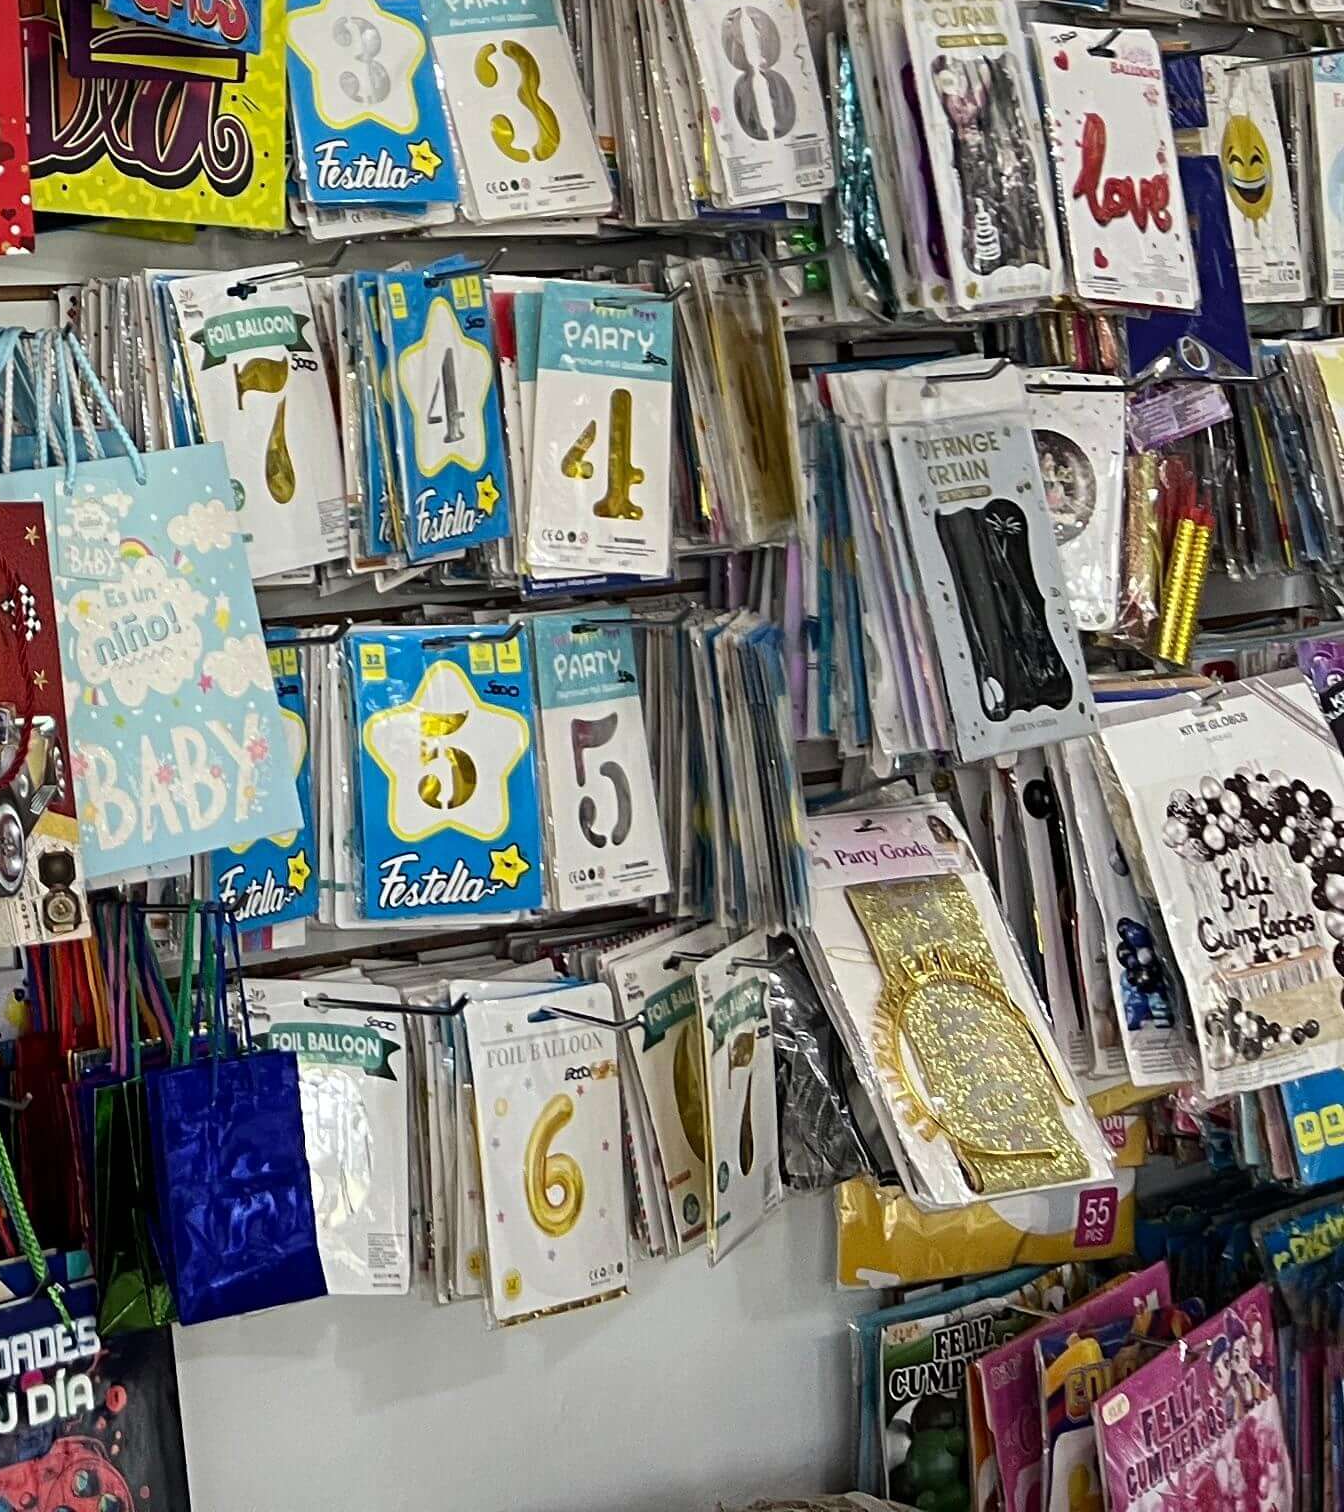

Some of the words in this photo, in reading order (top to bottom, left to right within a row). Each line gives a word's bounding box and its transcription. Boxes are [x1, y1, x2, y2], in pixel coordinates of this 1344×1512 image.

[332, 16, 392, 105] 3
[720, 5, 798, 142] 8
[474, 39, 561, 164] 3
[313, 138, 418, 190] Festella
[1072, 111, 1174, 233] love
[207, 323, 235, 347] FOIL
[236, 313, 296, 342] BALLOON
[562, 319, 655, 354] PARTY
[425, 346, 466, 444] 4
[233, 354, 297, 506] 7
[414, 487, 484, 545] Festella
[67, 544, 124, 575] BABY
[103, 589, 128, 608] Es
[132, 586, 158, 605] un
[95, 600, 182, 670] niño!
[552, 648, 622, 684] PARTY
[1208, 711, 1249, 732] GLOBOS
[74, 710, 275, 852] BABY
[417, 709, 478, 811] 5
[570, 711, 634, 849] 5
[376, 852, 506, 912] Festella
[833, 843, 878, 867] Party
[879, 840, 933, 863] Goods
[270, 1031, 308, 1054] FOIL
[308, 1032, 382, 1059] BALLOON
[486, 1045, 523, 1070] FOIL
[527, 1030, 605, 1064] BALLOON
[523, 1093, 586, 1239] 6
[1083, 1197, 1111, 1227] 55
[1084, 1227, 1105, 1243] PCS
[932, 1315, 995, 1362] FELIZ
[26, 1368, 95, 1427] DÍA
[888, 1358, 966, 1402] CUMP
[1138, 1367, 1201, 1448] FELIZ
